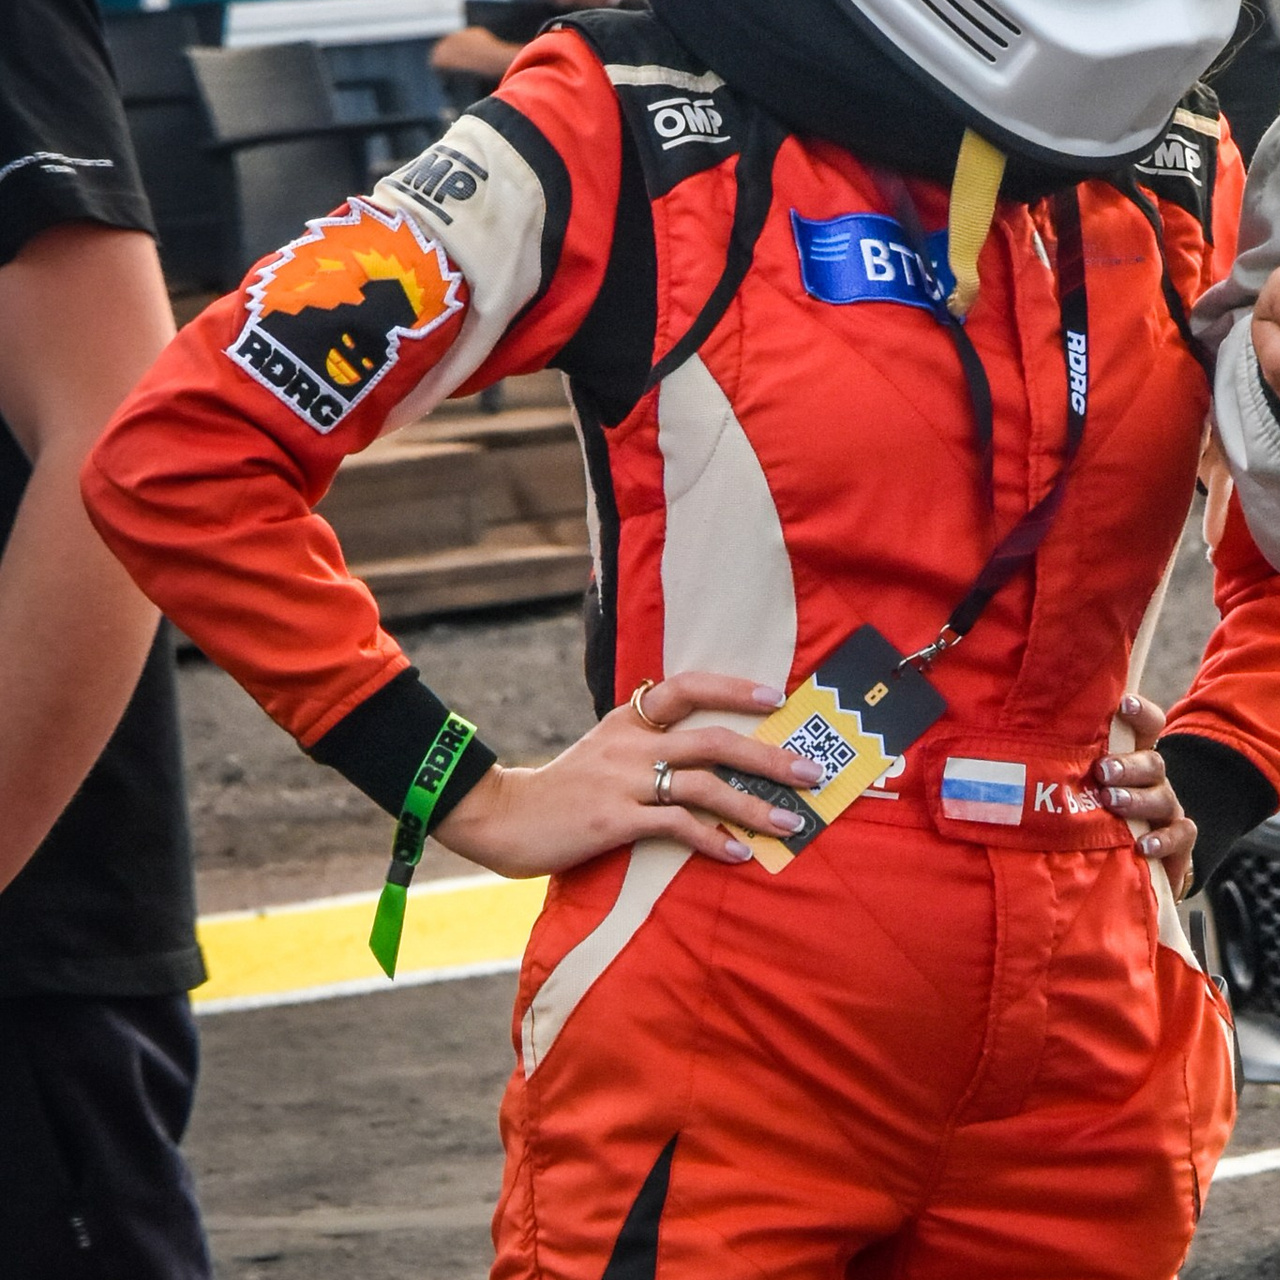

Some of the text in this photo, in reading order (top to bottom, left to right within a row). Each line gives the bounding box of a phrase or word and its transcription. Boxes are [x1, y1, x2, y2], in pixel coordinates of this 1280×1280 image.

[652, 104, 724, 138] OMP
[398, 152, 478, 205] MP
[1139, 139, 1202, 173] MP
[235, 329, 344, 427] RDRC
[1066, 330, 1087, 416] RDRC
[414, 719, 470, 794] RDRC
